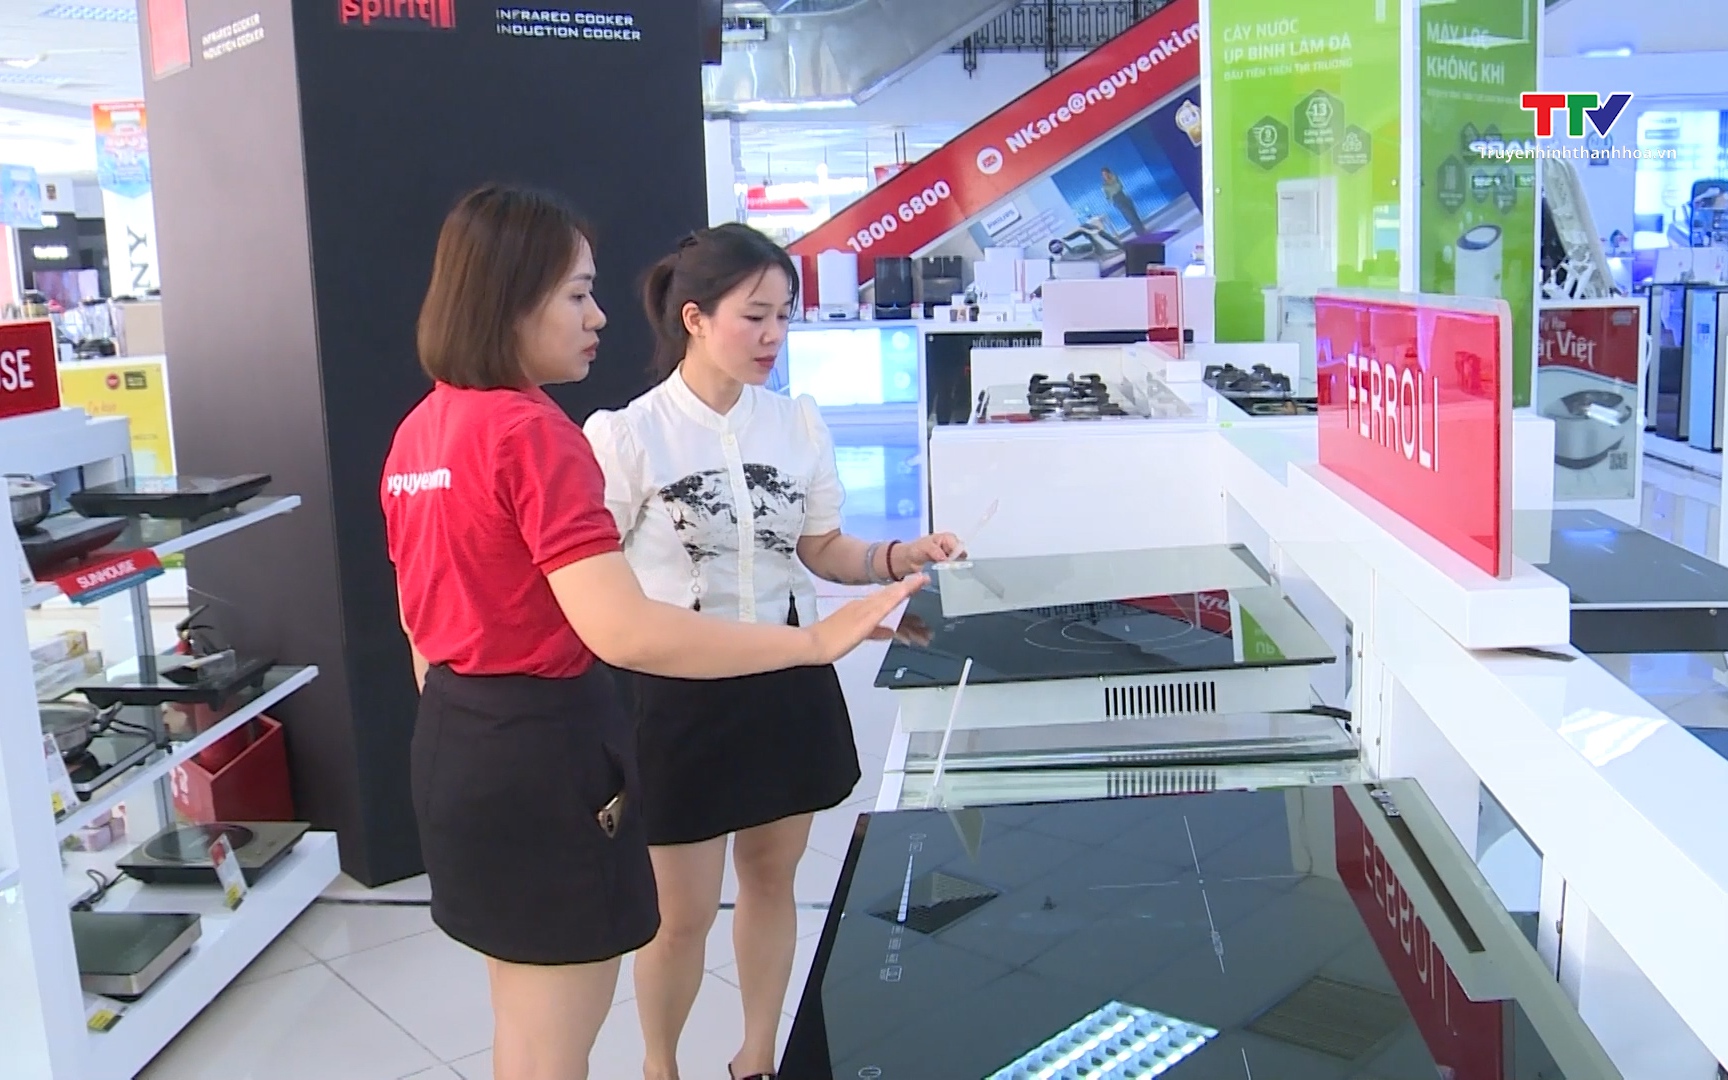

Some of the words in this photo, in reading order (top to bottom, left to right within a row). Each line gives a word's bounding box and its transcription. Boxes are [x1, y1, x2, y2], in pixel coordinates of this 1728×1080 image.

[496, 9, 571, 23] INFRARED
[575, 12, 634, 26] COOKER
[496, 24, 579, 38] INDUCTION
[583, 27, 641, 41] COOKER
[1005, 22, 1199, 153] NKare@nguyenkim
[846, 213, 898, 253] 1800
[898, 180, 951, 222] 6800
[1347, 353, 1439, 473] FERROLI
